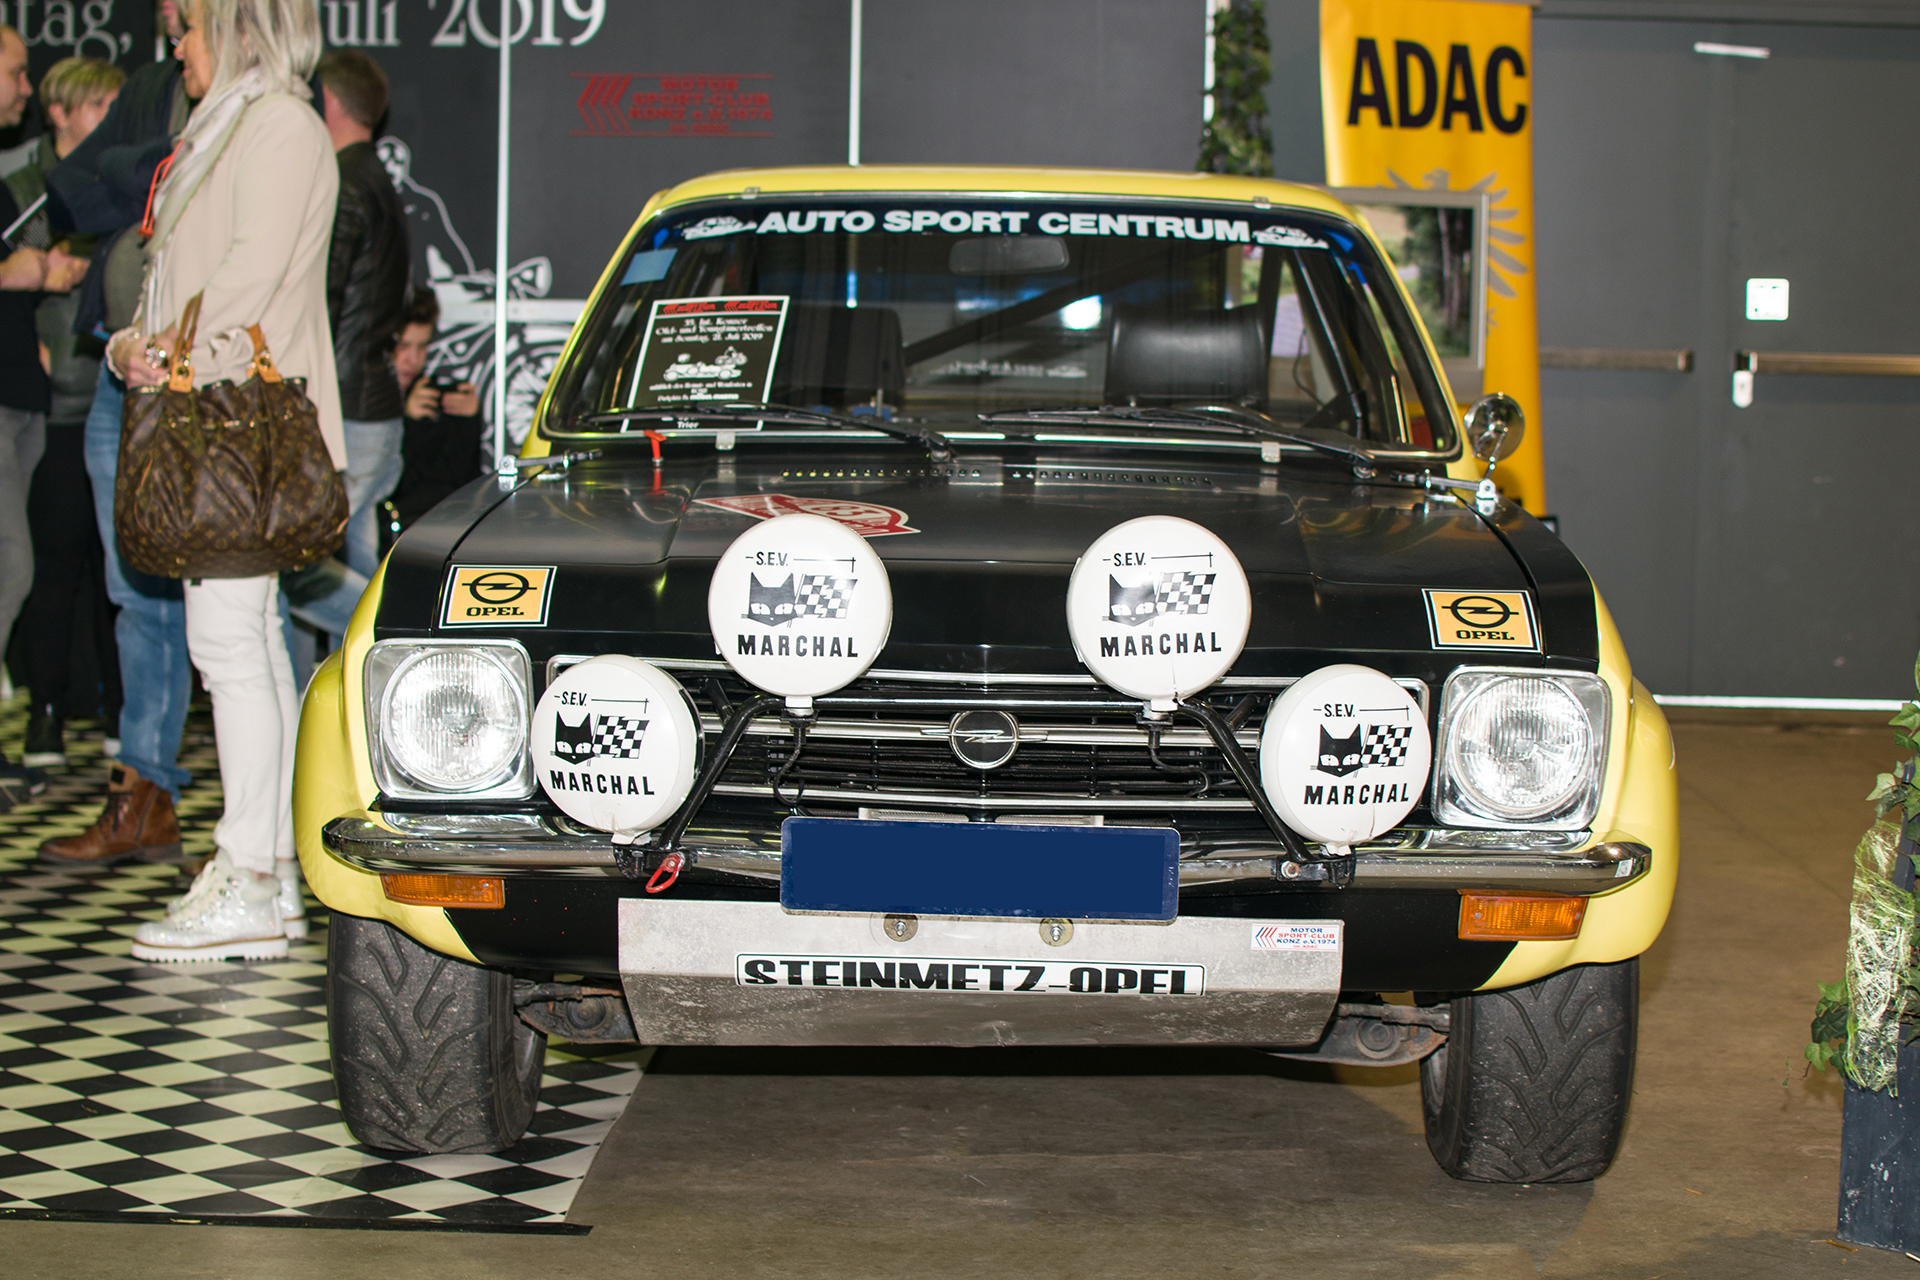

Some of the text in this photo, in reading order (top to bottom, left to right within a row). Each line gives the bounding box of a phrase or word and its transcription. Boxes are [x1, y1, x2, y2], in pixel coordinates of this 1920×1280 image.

[0, 0, 131, 66] tag,
[660, 79, 739, 92] MOTOR
[1346, 37, 1528, 135] ADAC
[632, 92, 770, 106] SPORT-CLUB
[628, 107, 687, 121] KONZ
[756, 210, 1251, 243] AUTO SPORT CENTRUM
[742, 332, 763, 341] 2019
[677, 421, 699, 429] Trier
[756, 551, 788, 566] S.E.V.
[1114, 552, 1146, 567] S.E.V.
[466, 606, 524, 617] OPEL
[1456, 630, 1515, 641] OPEL
[737, 634, 858, 658] MARCHAL
[1100, 632, 1222, 658] MARCHAL
[561, 691, 587, 707] S.E.V.
[1324, 703, 1355, 718] S.E.V.
[550, 770, 655, 796] MARCHAL
[1304, 783, 1410, 805] MARCHAL
[744, 959, 1197, 995] STEINMETZ-OPEL
